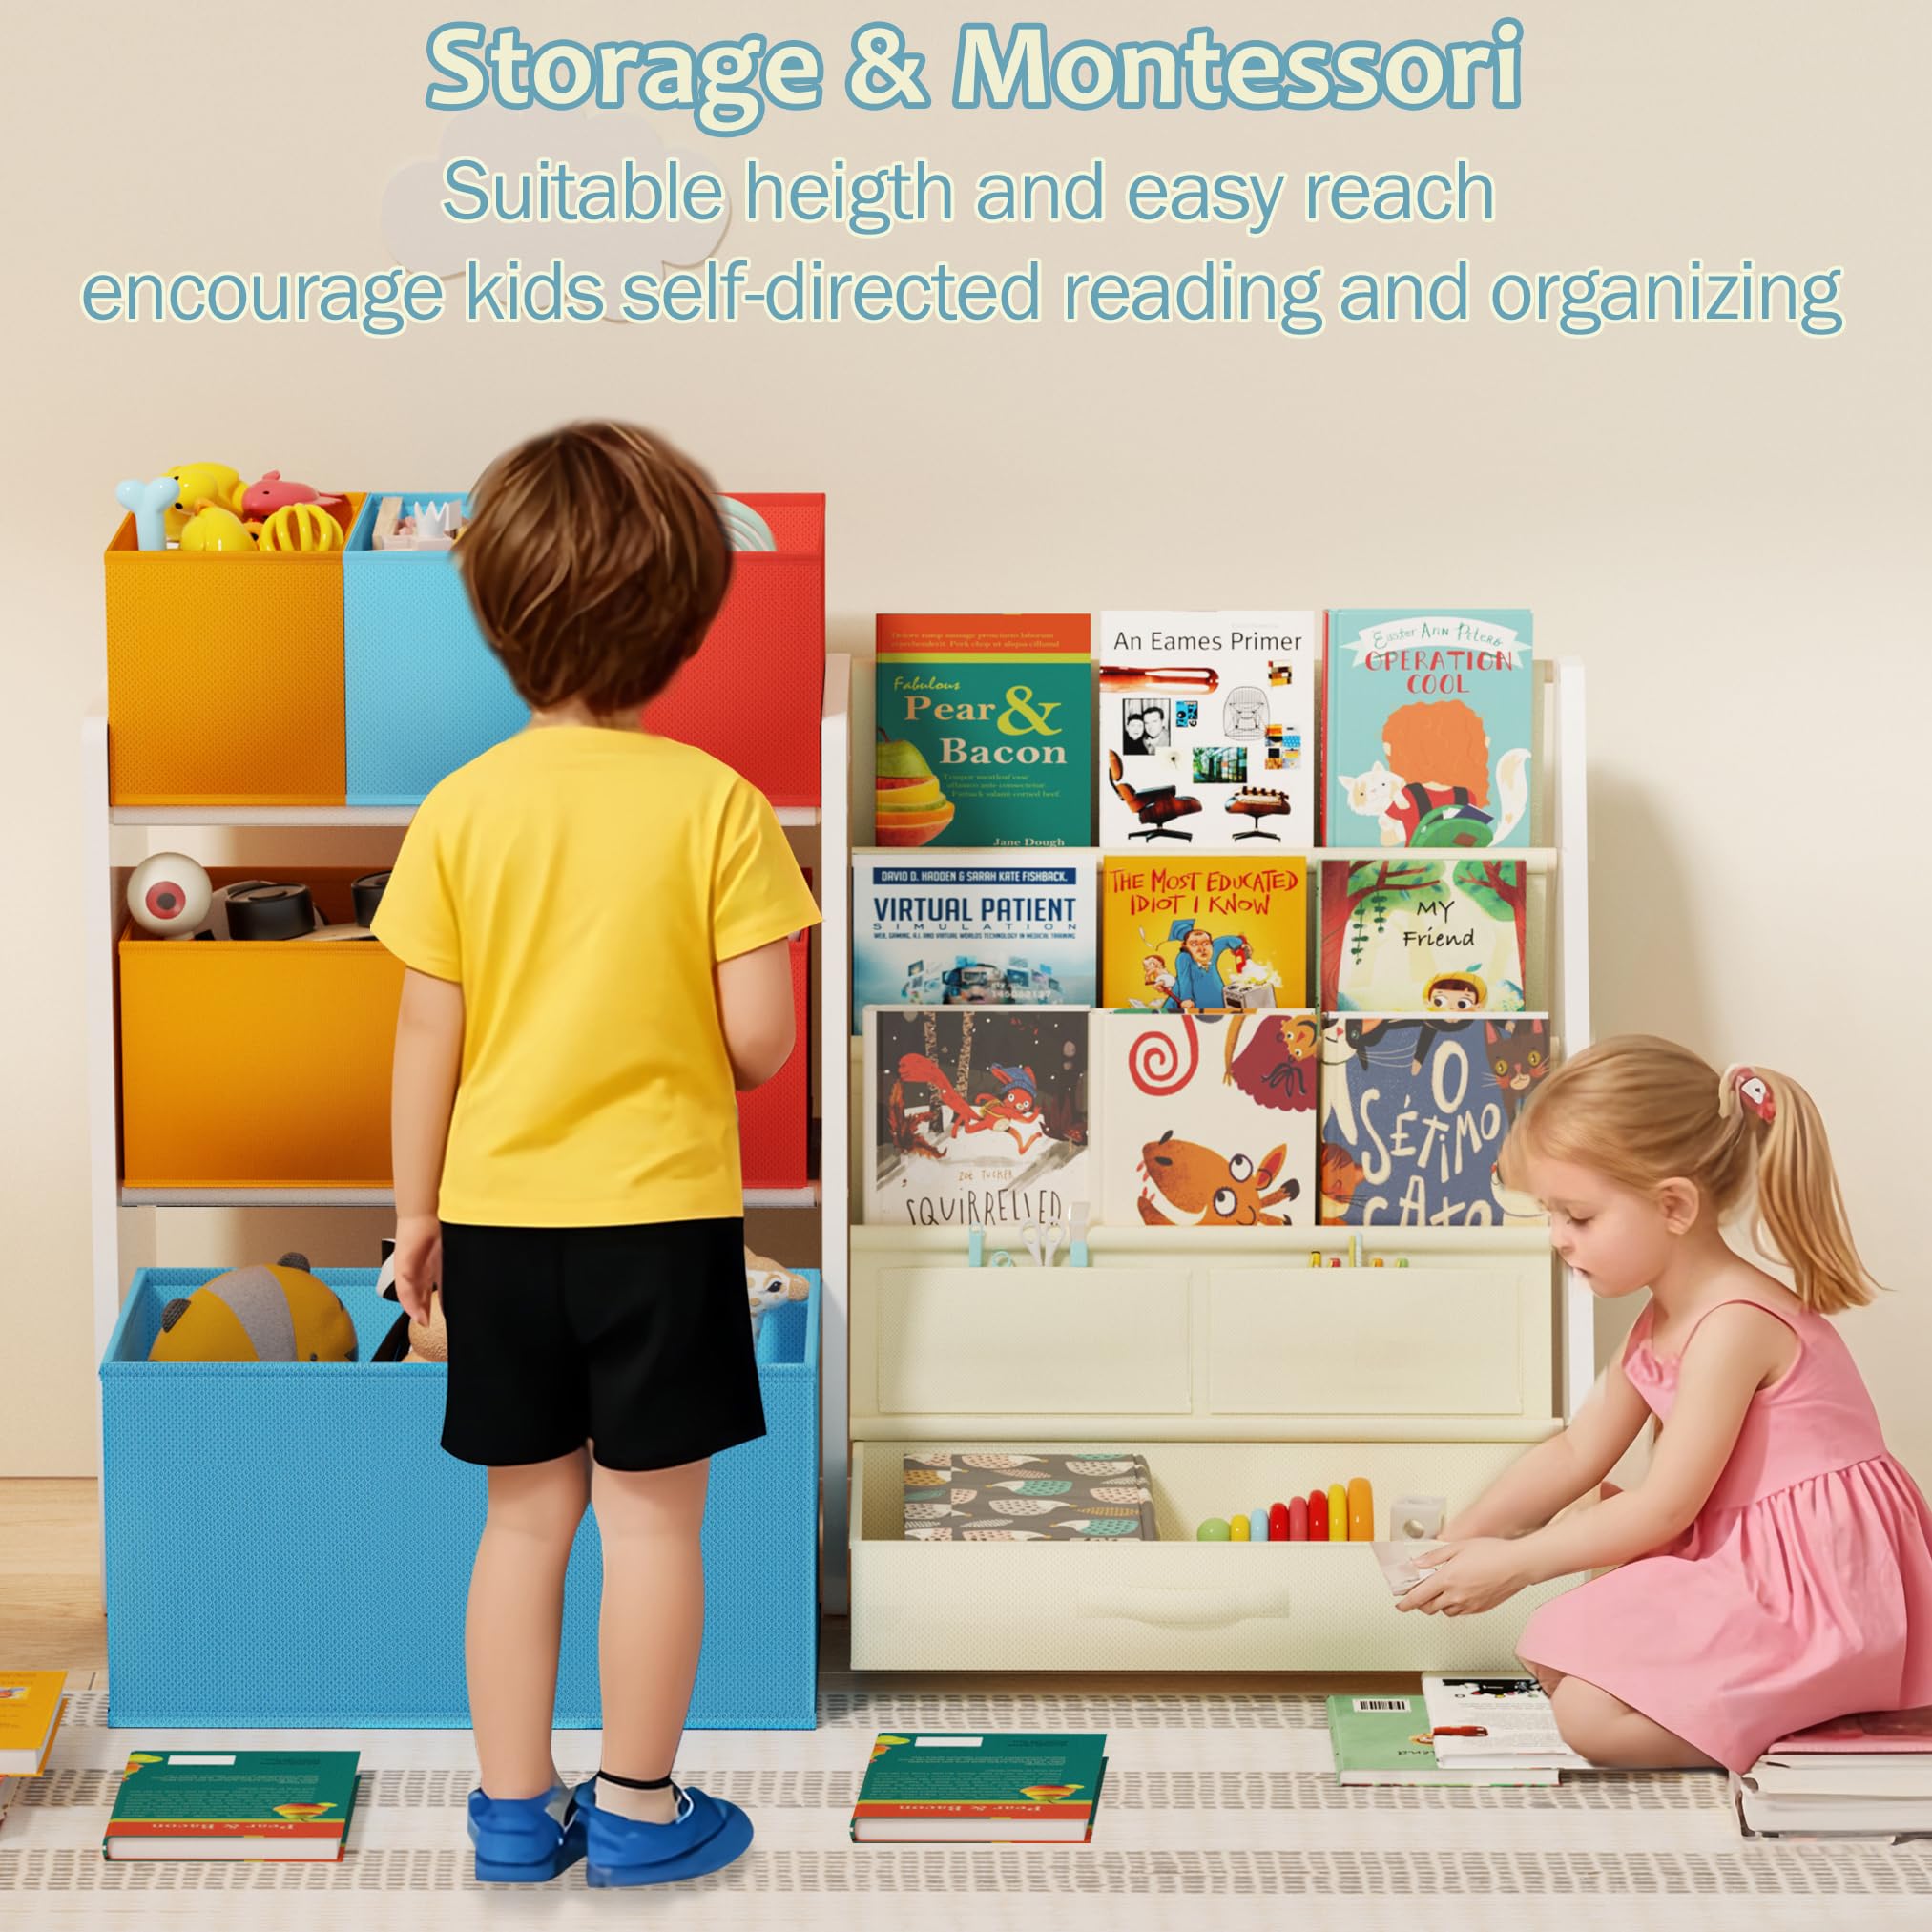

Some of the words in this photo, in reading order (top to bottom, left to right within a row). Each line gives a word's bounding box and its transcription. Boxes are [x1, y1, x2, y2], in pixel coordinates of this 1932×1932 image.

[1113, 631, 1142, 651] An
[1151, 631, 1222, 651] Eames
[1231, 631, 1302, 651] Primer
[1365, 650, 1513, 671] OPERATION
[893, 676, 961, 691] Fabulous
[1407, 674, 1470, 695] COOL
[904, 696, 996, 720] Pear
[997, 685, 1062, 736] &
[940, 737, 1068, 764] Bacon
[993, 838, 1021, 846] Jane
[1024, 837, 1065, 847] Dough
[881, 870, 907, 882] DAVID
[910, 870, 920, 882] D.
[921, 870, 956, 882] HADDEN
[958, 870, 965, 882] &
[966, 870, 996, 882] SARAH
[998, 870, 1021, 882] KATE
[1110, 868, 1145, 893] THE
[1151, 867, 1202, 893] MOST
[1206, 869, 1298, 893] EDUCATED
[874, 897, 973, 922] VIRTUAL
[981, 897, 1076, 922] PATIENT
[1131, 894, 1185, 916] IDIOT
[1194, 895, 1199, 914] I
[1208, 892, 1270, 915] KNOW
[1417, 901, 1456, 924] MY
[1403, 926, 1475, 947] Friend
[1432, 1040, 1469, 1113] O
